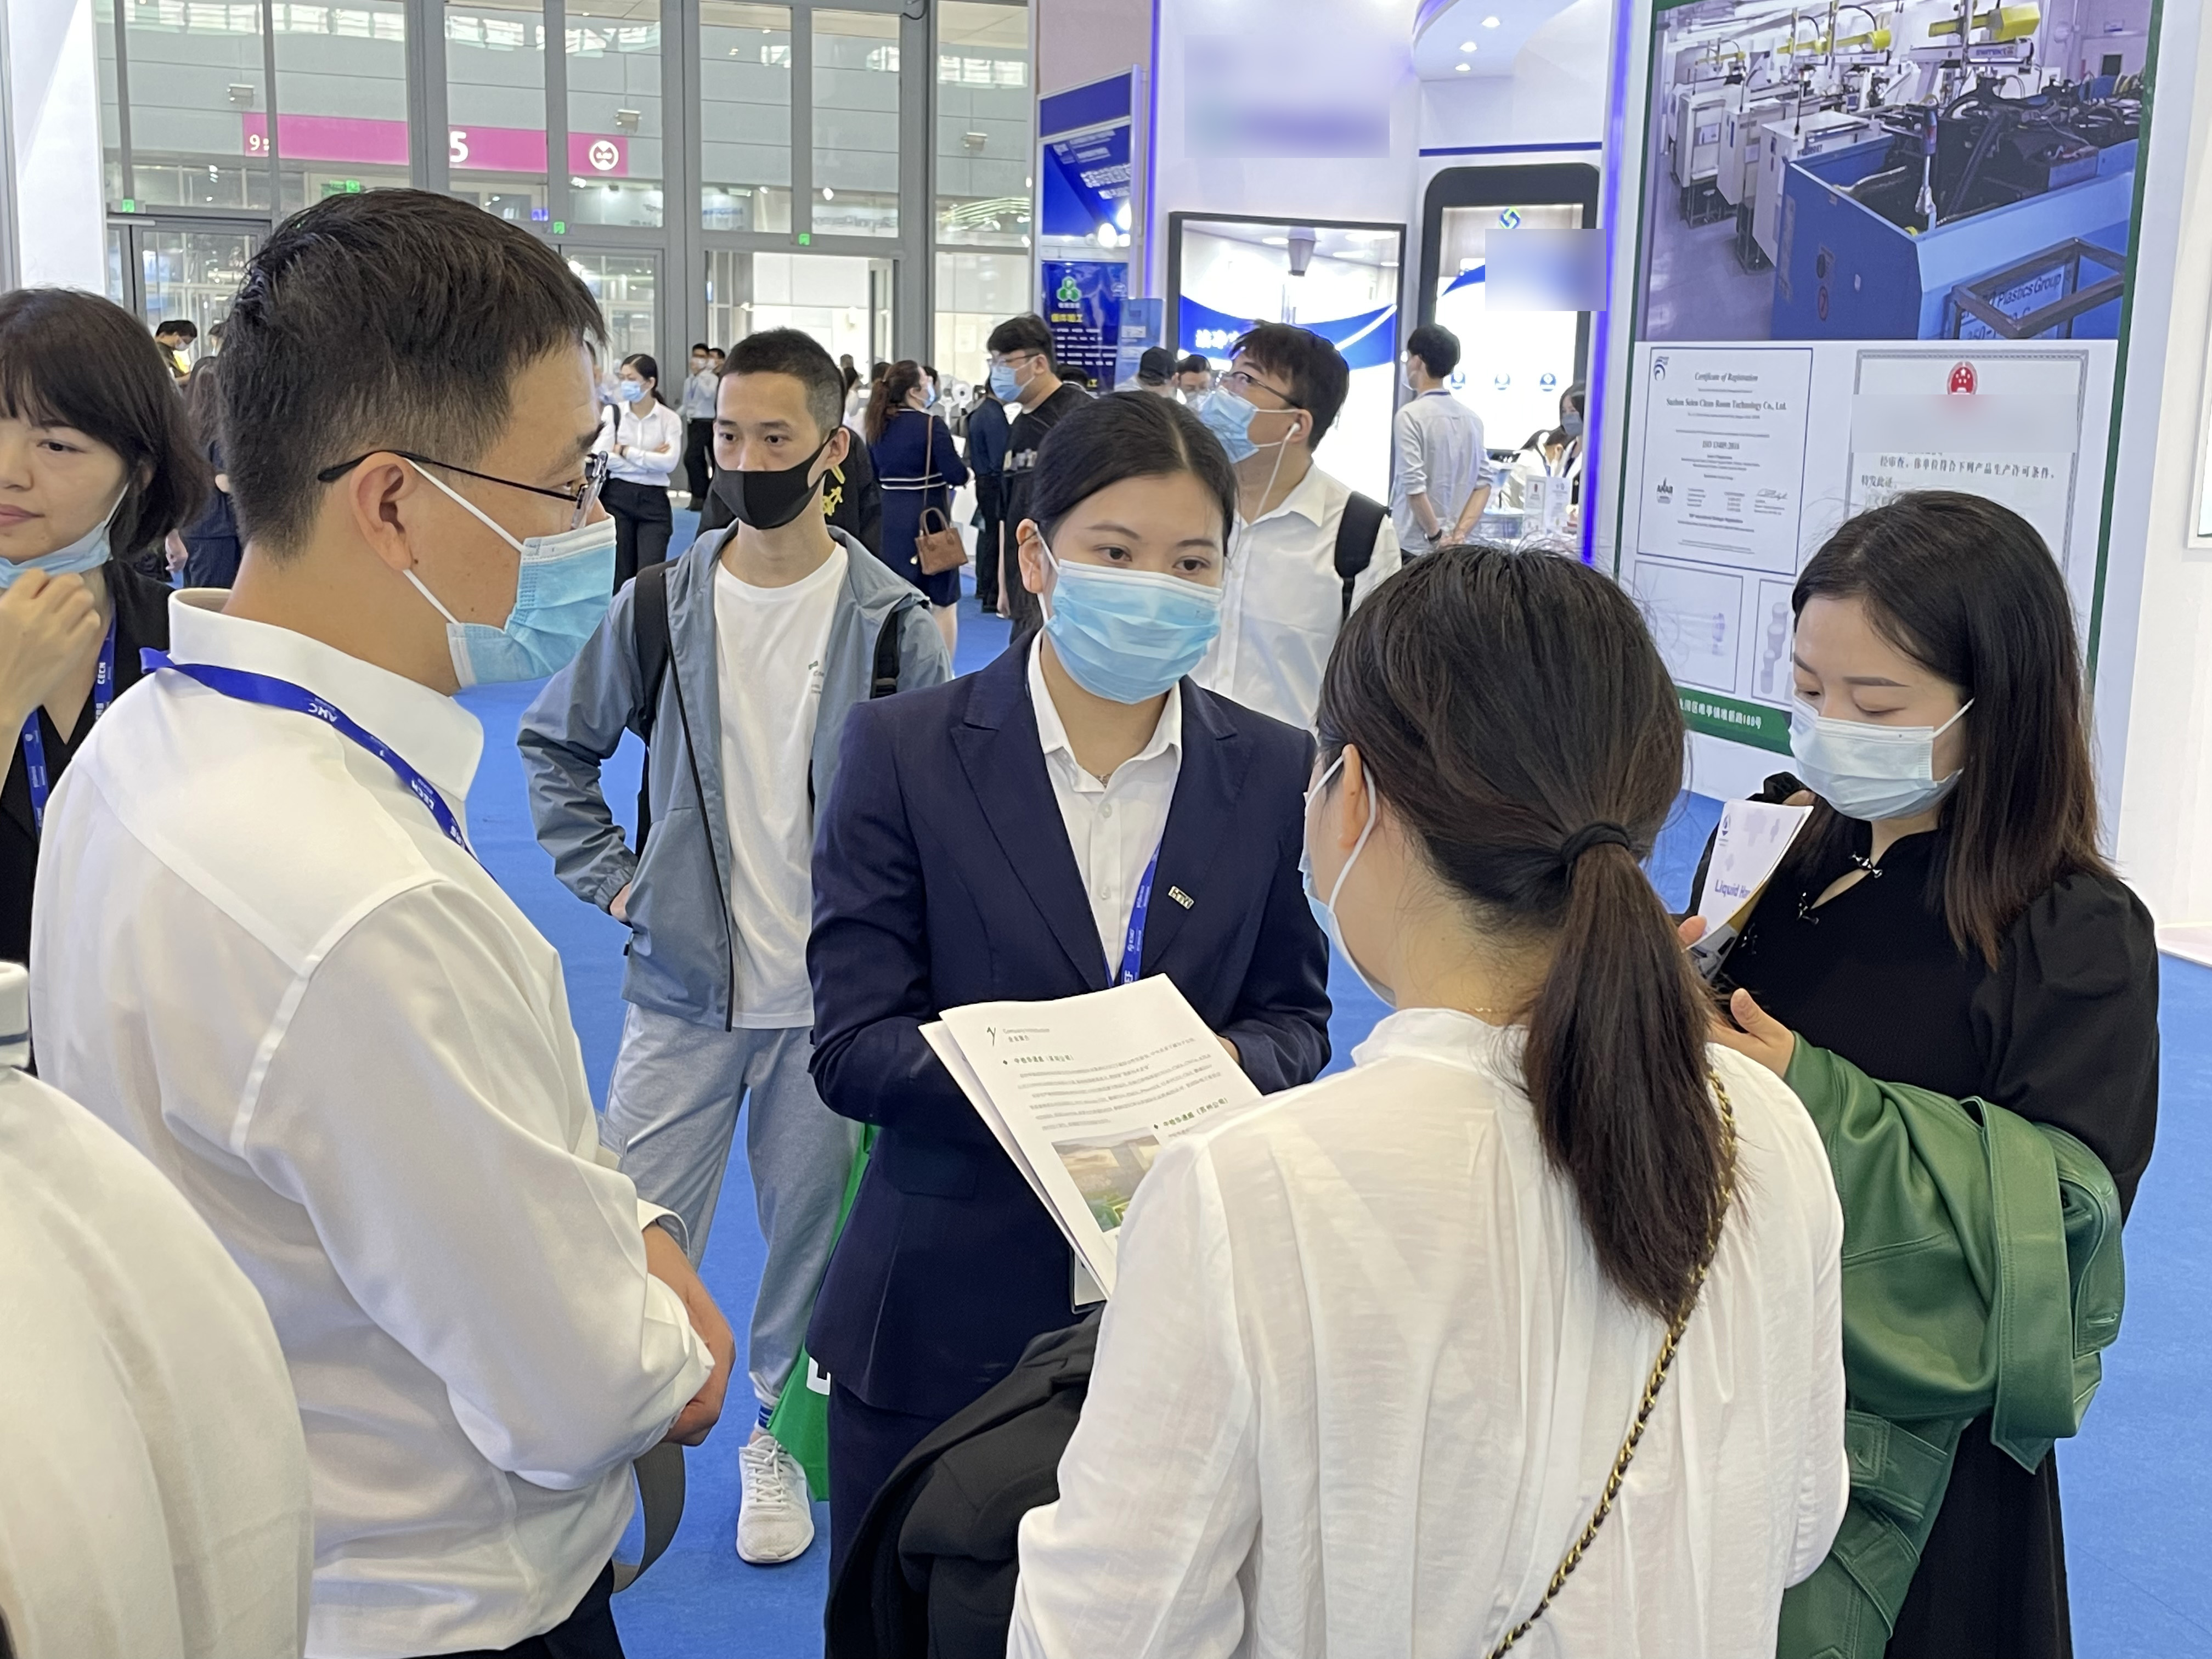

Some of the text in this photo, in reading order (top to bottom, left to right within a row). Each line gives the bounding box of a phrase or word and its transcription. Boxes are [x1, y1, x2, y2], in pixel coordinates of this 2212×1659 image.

[1997, 274, 2061, 307] Plastics Group
[1715, 879, 1740, 898] Liquid
